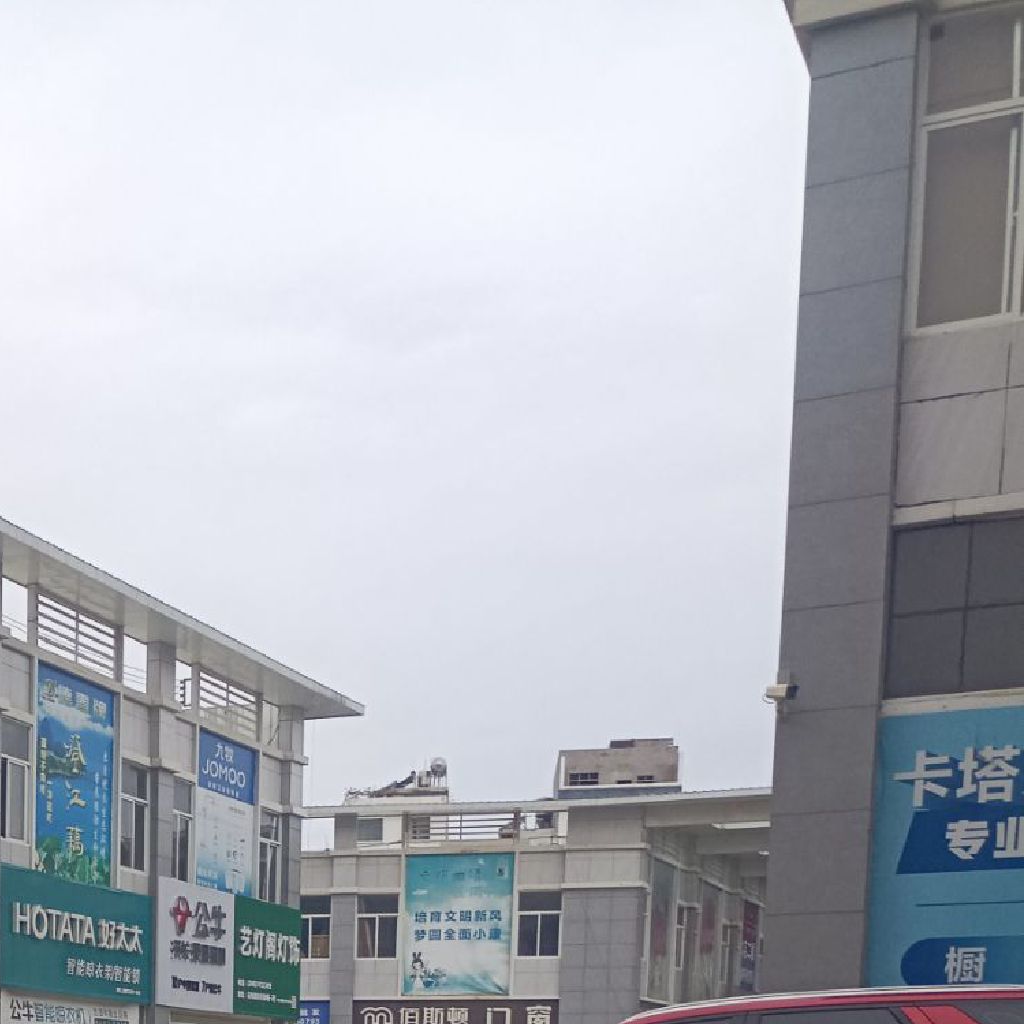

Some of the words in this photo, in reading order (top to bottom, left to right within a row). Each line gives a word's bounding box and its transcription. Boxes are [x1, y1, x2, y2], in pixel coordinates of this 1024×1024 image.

[202, 758, 246, 788] JOMOO
[13, 902, 96, 947] HOTATA
[945, 946, 987, 984] 橱
